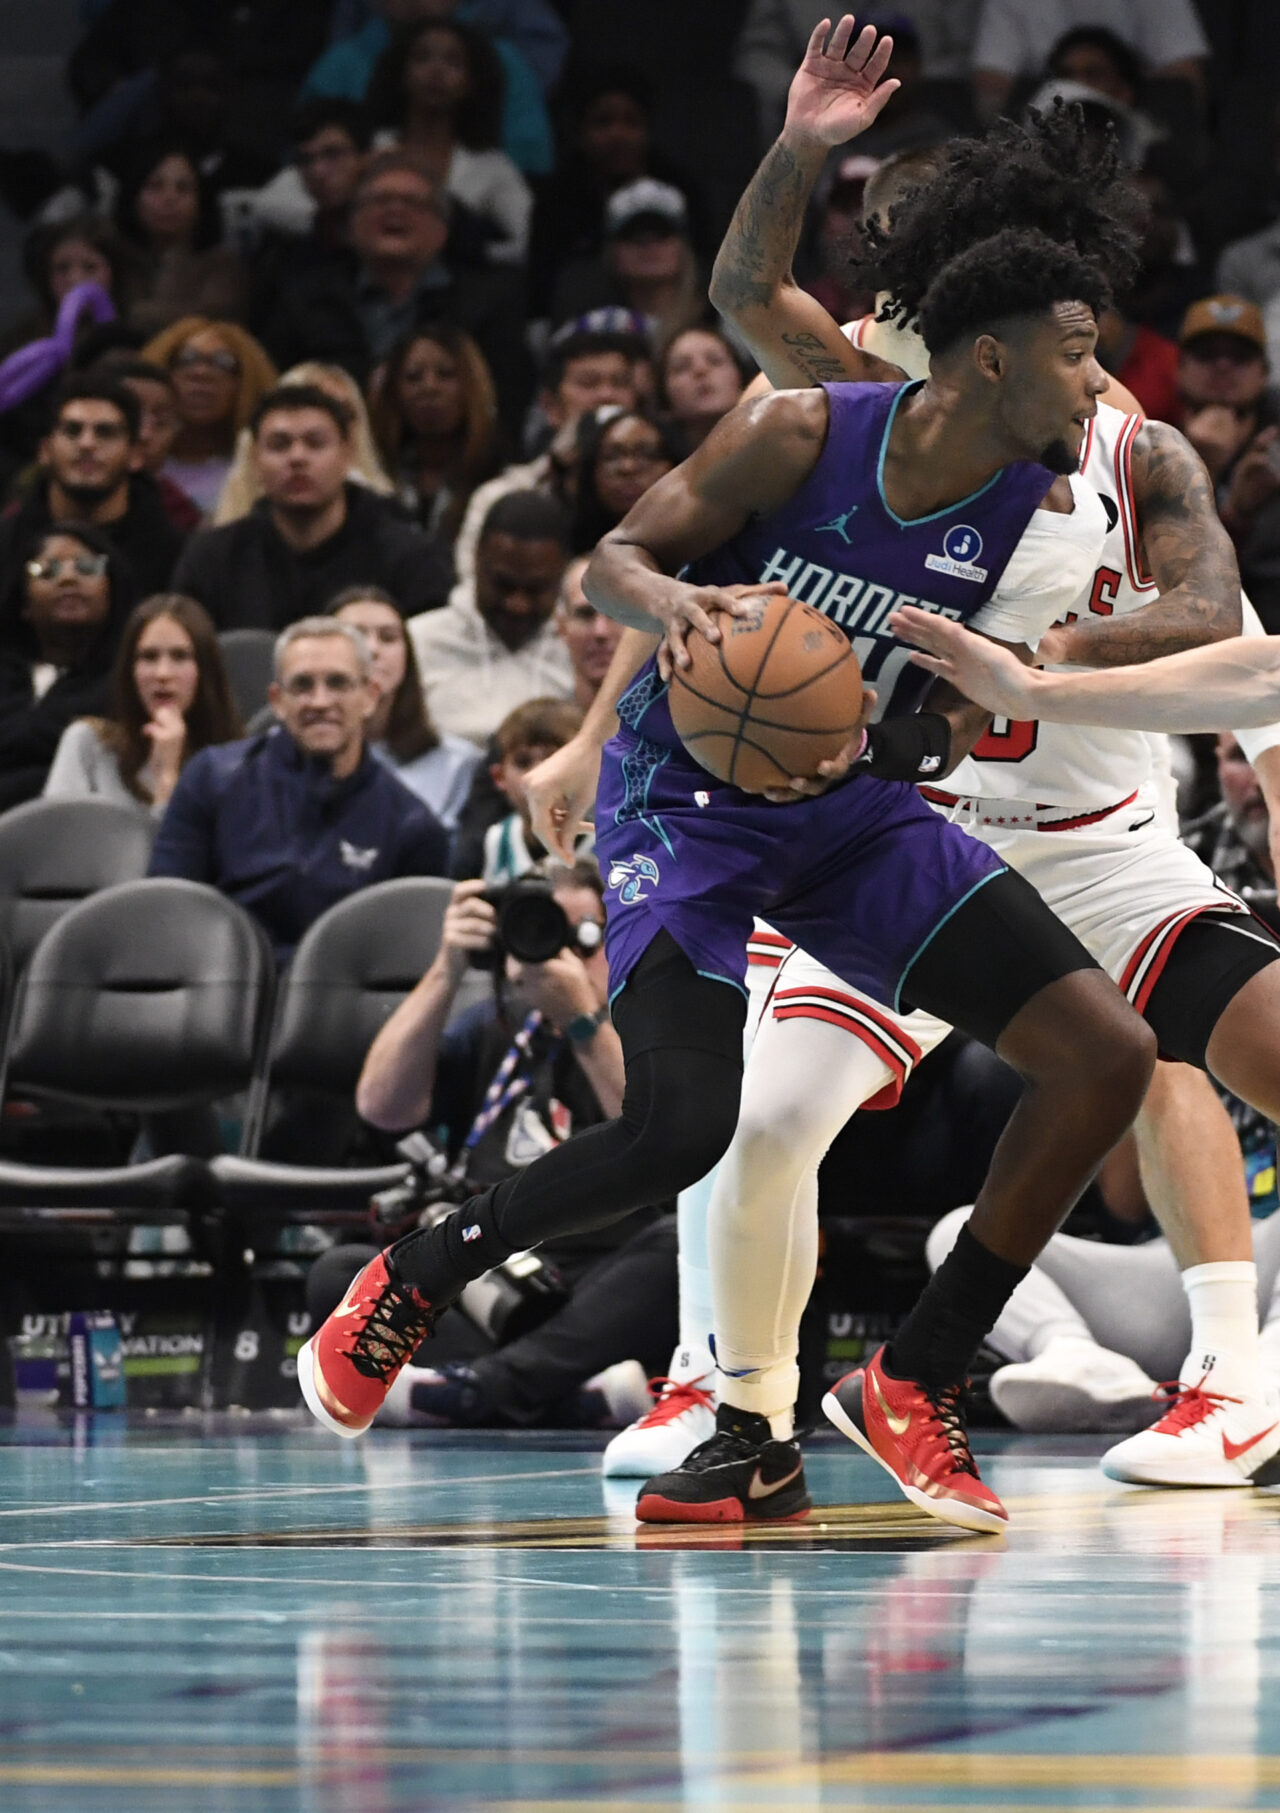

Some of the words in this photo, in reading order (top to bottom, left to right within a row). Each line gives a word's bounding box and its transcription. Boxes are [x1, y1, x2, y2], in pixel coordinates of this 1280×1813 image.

[927, 557, 952, 572] Judi
[952, 563, 985, 581] Health
[235, 1330, 259, 1362] 8
